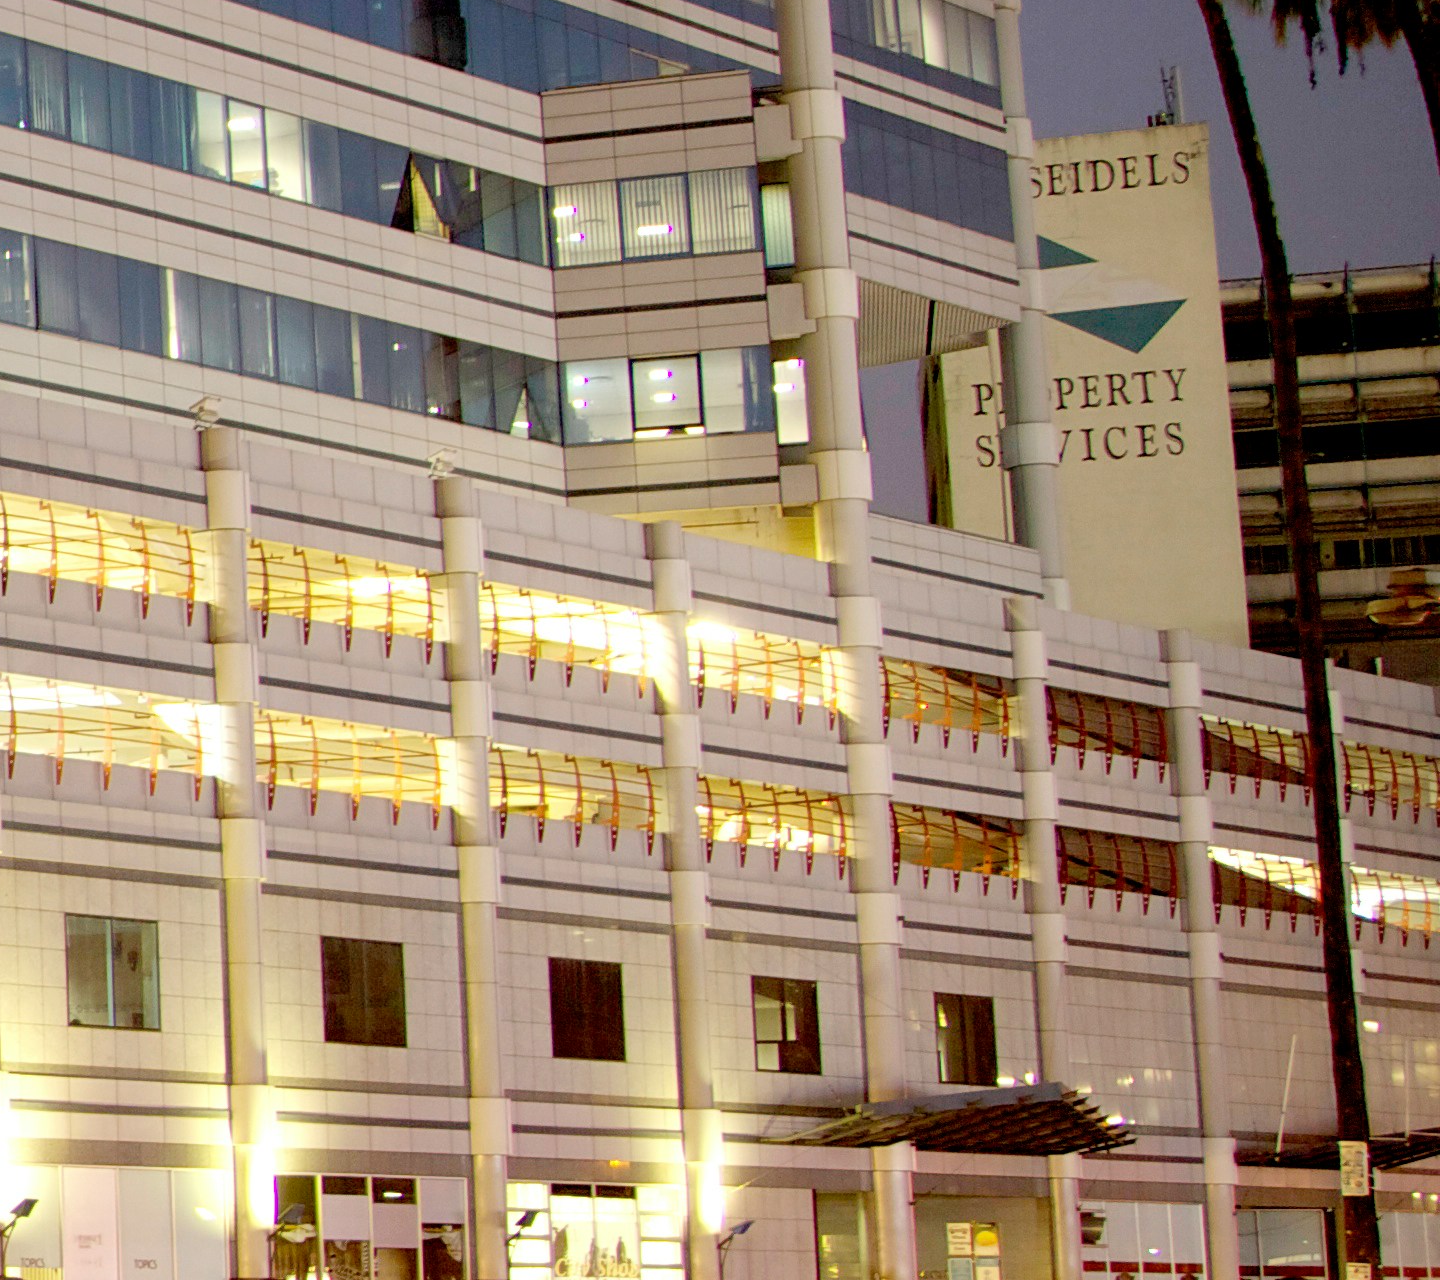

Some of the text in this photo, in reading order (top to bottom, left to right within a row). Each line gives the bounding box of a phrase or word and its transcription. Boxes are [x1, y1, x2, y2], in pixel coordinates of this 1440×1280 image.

[971, 368, 1187, 415] PPERTY
[976, 422, 1184, 470] SVICES
[21, 1257, 45, 1268] TOPICS
[134, 1258, 157, 1269] TOPICS
